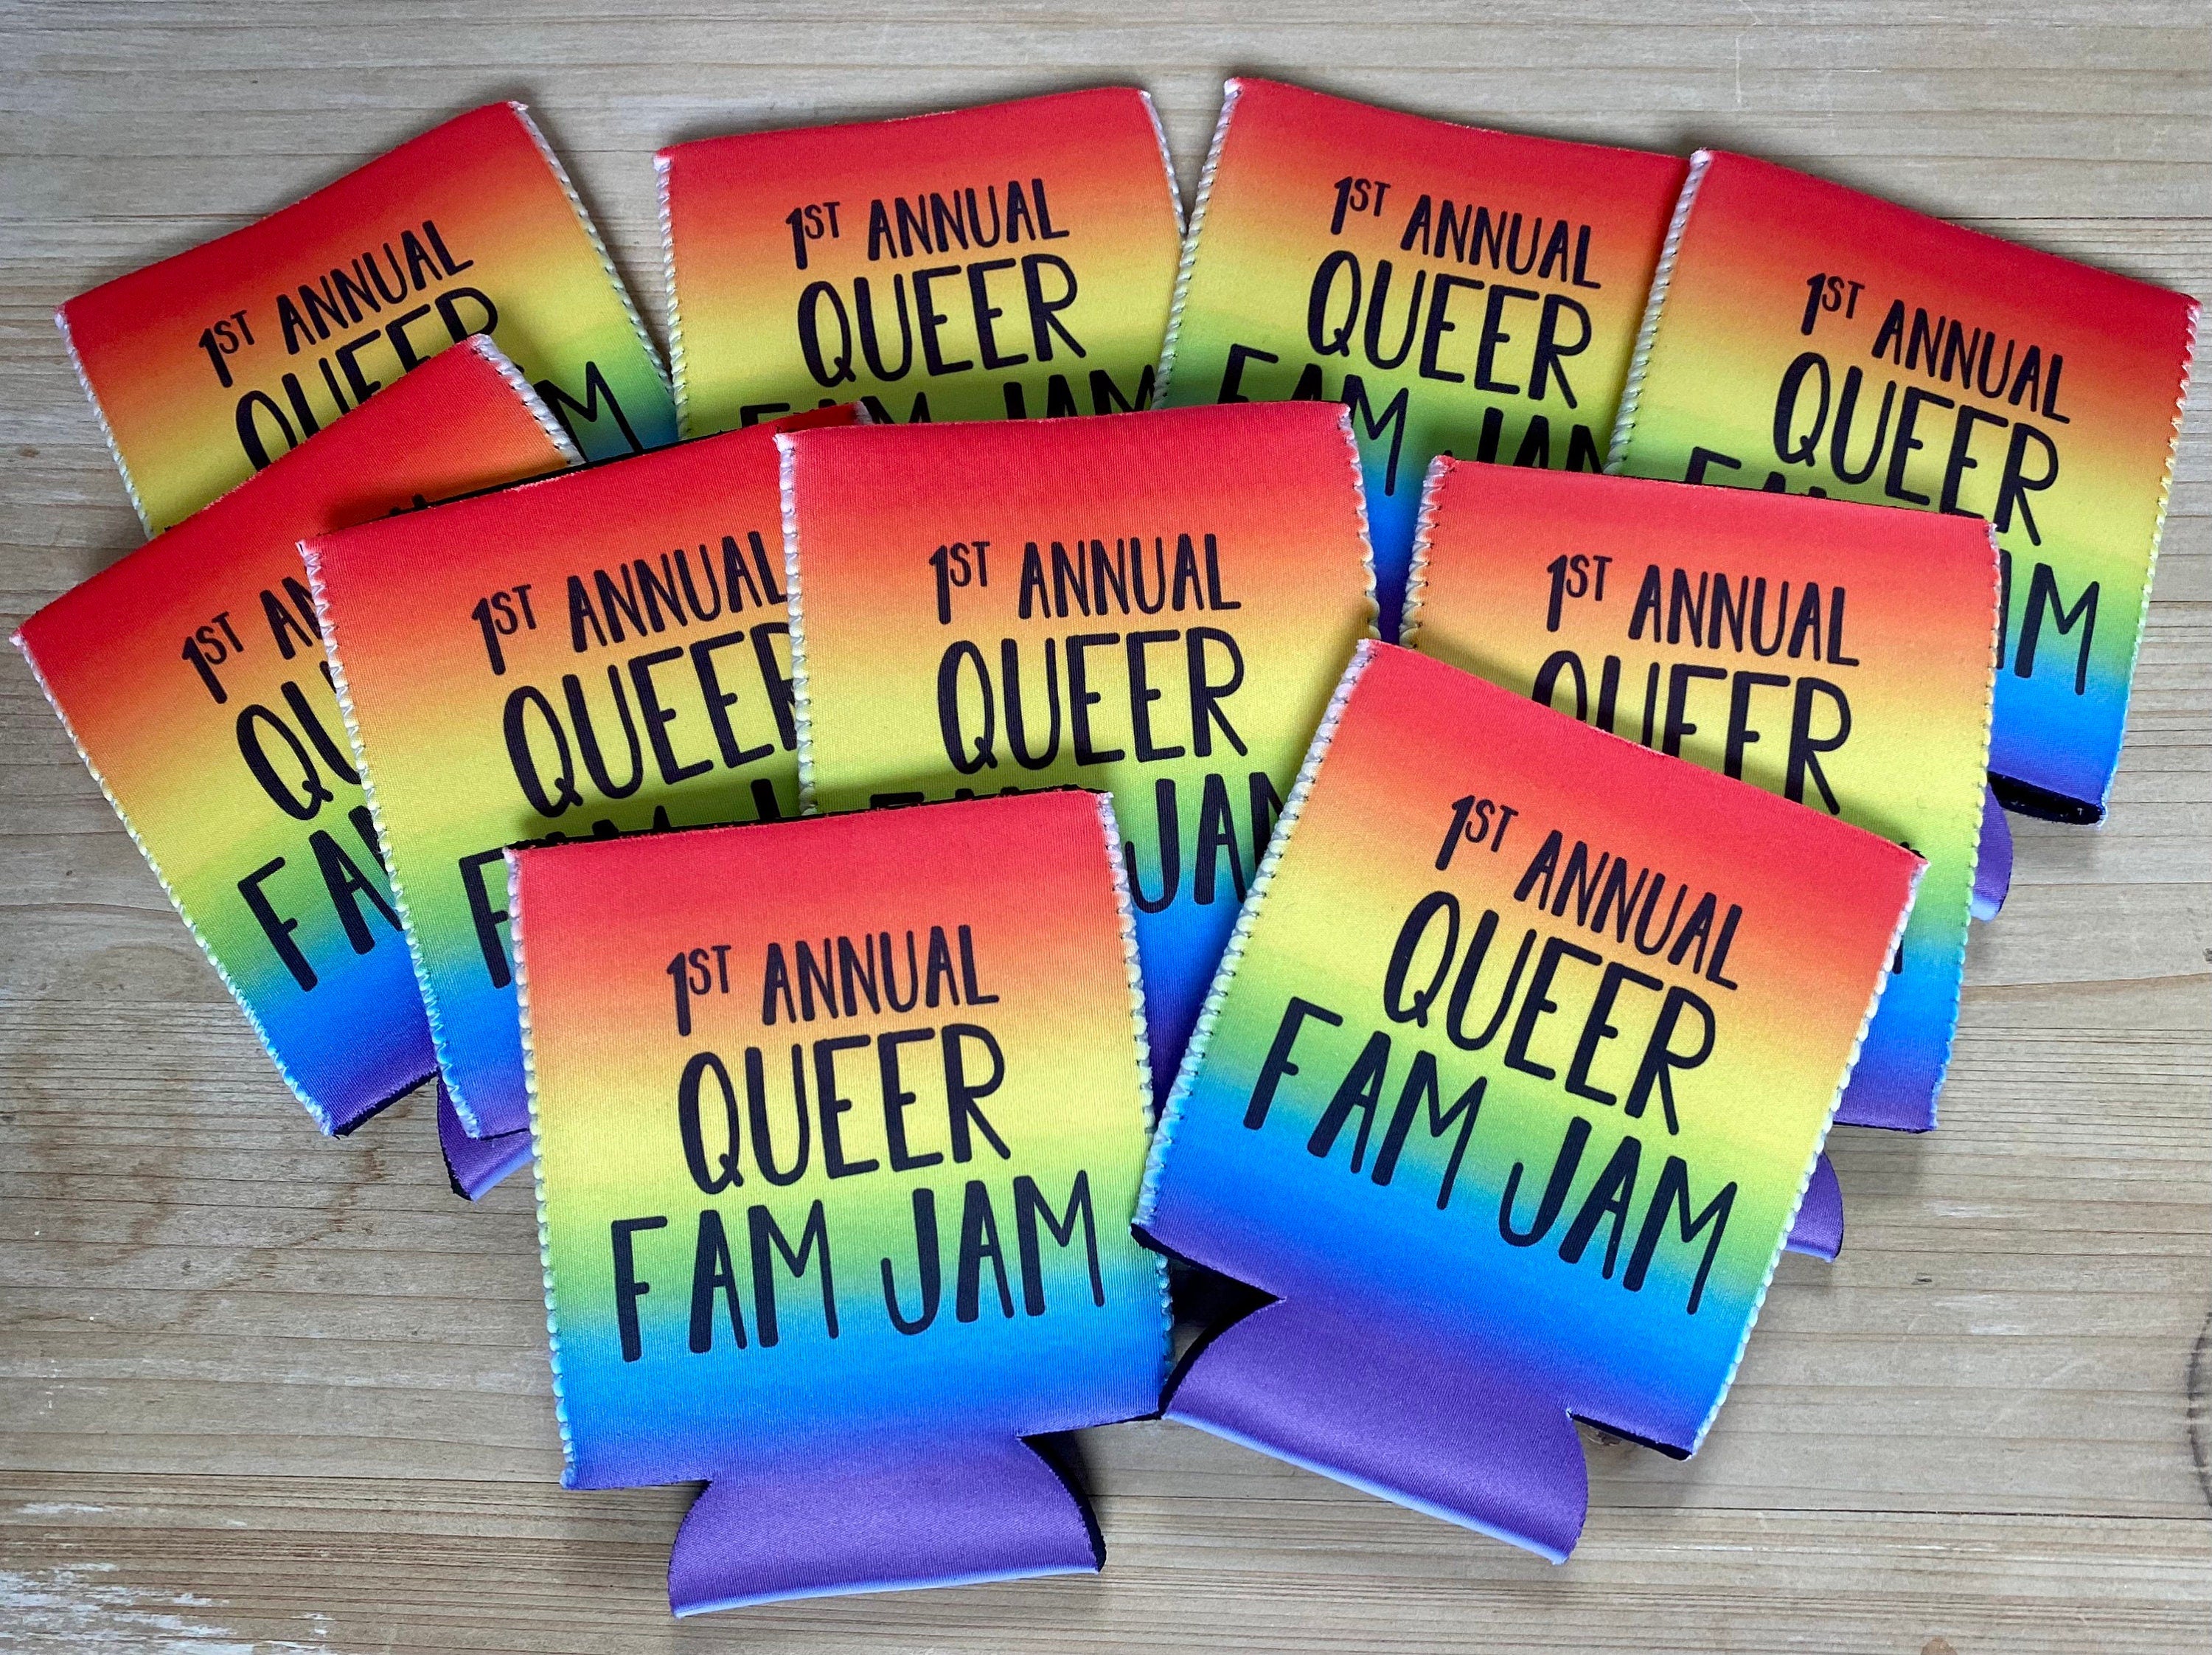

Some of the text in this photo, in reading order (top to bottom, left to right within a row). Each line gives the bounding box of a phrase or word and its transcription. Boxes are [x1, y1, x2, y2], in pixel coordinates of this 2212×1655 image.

[785, 178, 1070, 270] 1ST ANNUAL
[1330, 177, 1601, 289] 1ST ANNUAL
[198, 220, 474, 388] 1ST ANNUAL
[797, 253, 1087, 389] QUEER
[1307, 250, 1592, 409] QUEER
[1801, 273, 2070, 424] 1ST ANNUAL
[1773, 352, 2059, 547] QUEER
[470, 531, 788, 676] 1ST ANNUAL
[928, 533, 1242, 625] 1ST ANNUAL
[1546, 555, 1860, 667] 1ST ANNUAL
[181, 611, 245, 704] 1ST
[503, 622, 797, 818] QUEER
[937, 626, 1248, 776] QUEER
[1434, 795, 1743, 990] 1ST ANNUAL
[666, 925, 1000, 1037] 1ST ANNUAL
[1383, 891, 1716, 1136] QUEER
[678, 1023, 1011, 1195] QUEER
[1243, 996, 1738, 1315] FAM JAM
[611, 1170, 1105, 1362] FAM JAM
